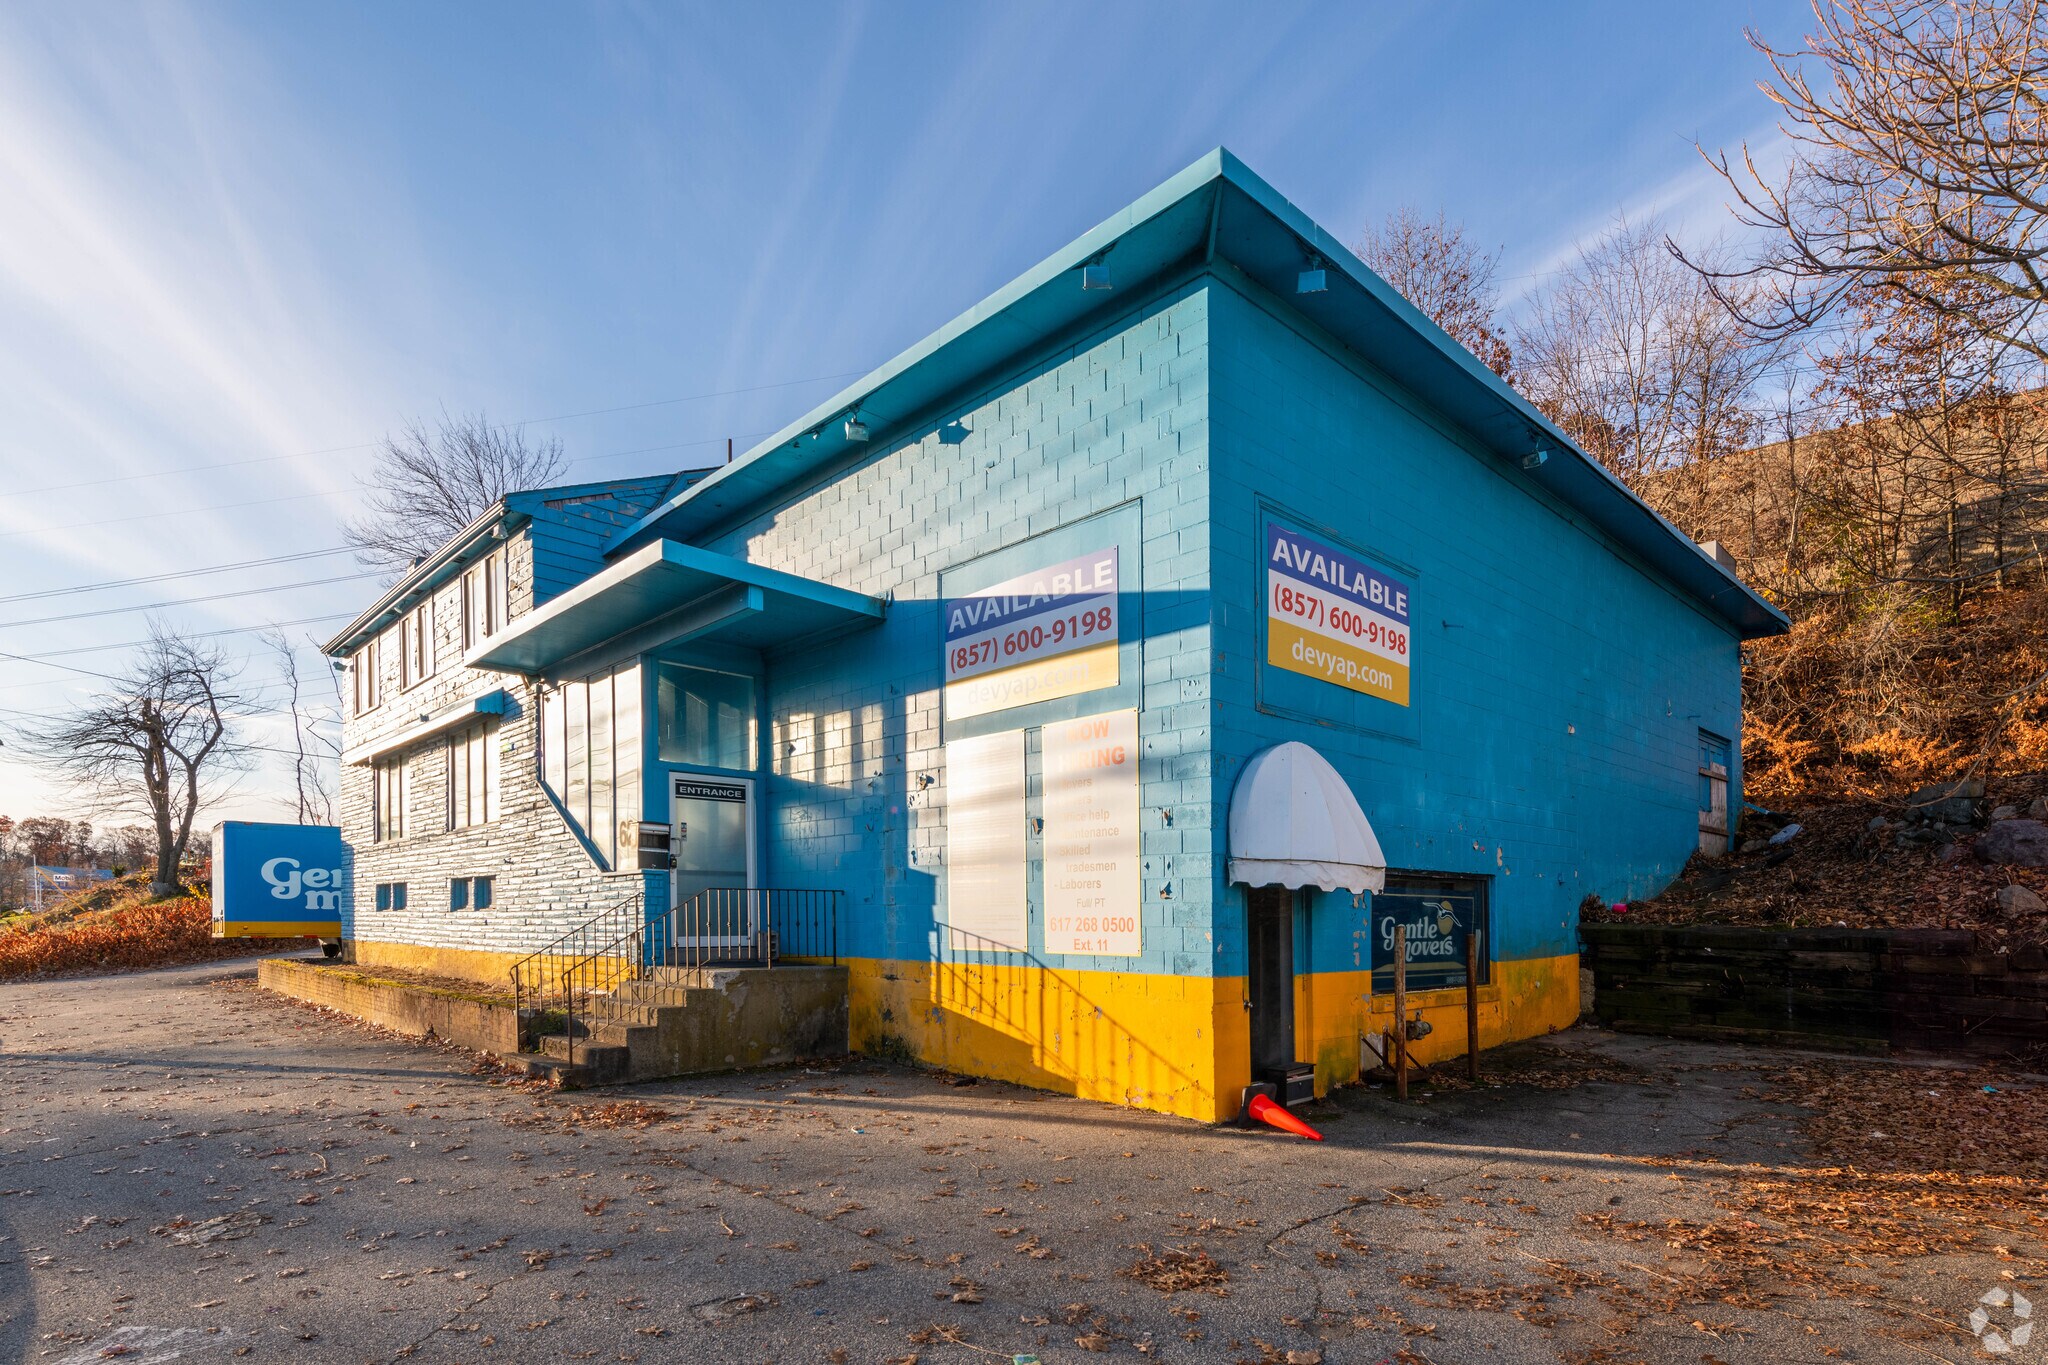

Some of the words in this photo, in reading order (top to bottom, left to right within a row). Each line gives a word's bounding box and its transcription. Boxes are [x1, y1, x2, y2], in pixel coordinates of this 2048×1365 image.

[1271, 537, 1408, 618] AVAILABLE
[948, 558, 1114, 634] AVAILABLE
[1274, 583, 1325, 628] (857)
[1329, 606, 1407, 656] 600-9198
[950, 636, 999, 674] (857)
[1003, 606, 1113, 656] 600-9198
[1291, 637, 1393, 691] devyap.com
[967, 661, 1090, 705] devyap.com
[679, 786, 742, 798] ENTRANCE
[1088, 808, 1110, 822] help
[1059, 879, 1102, 890] Laborers
[1066, 861, 1117, 873] tradesmen
[1050, 916, 1071, 932] 617
[1075, 916, 1098, 932] 268
[1102, 916, 1135, 933] 0500
[1381, 915, 1438, 951] Gntle
[1073, 938, 1094, 951] Ext.
[1096, 938, 1108, 952] 11
